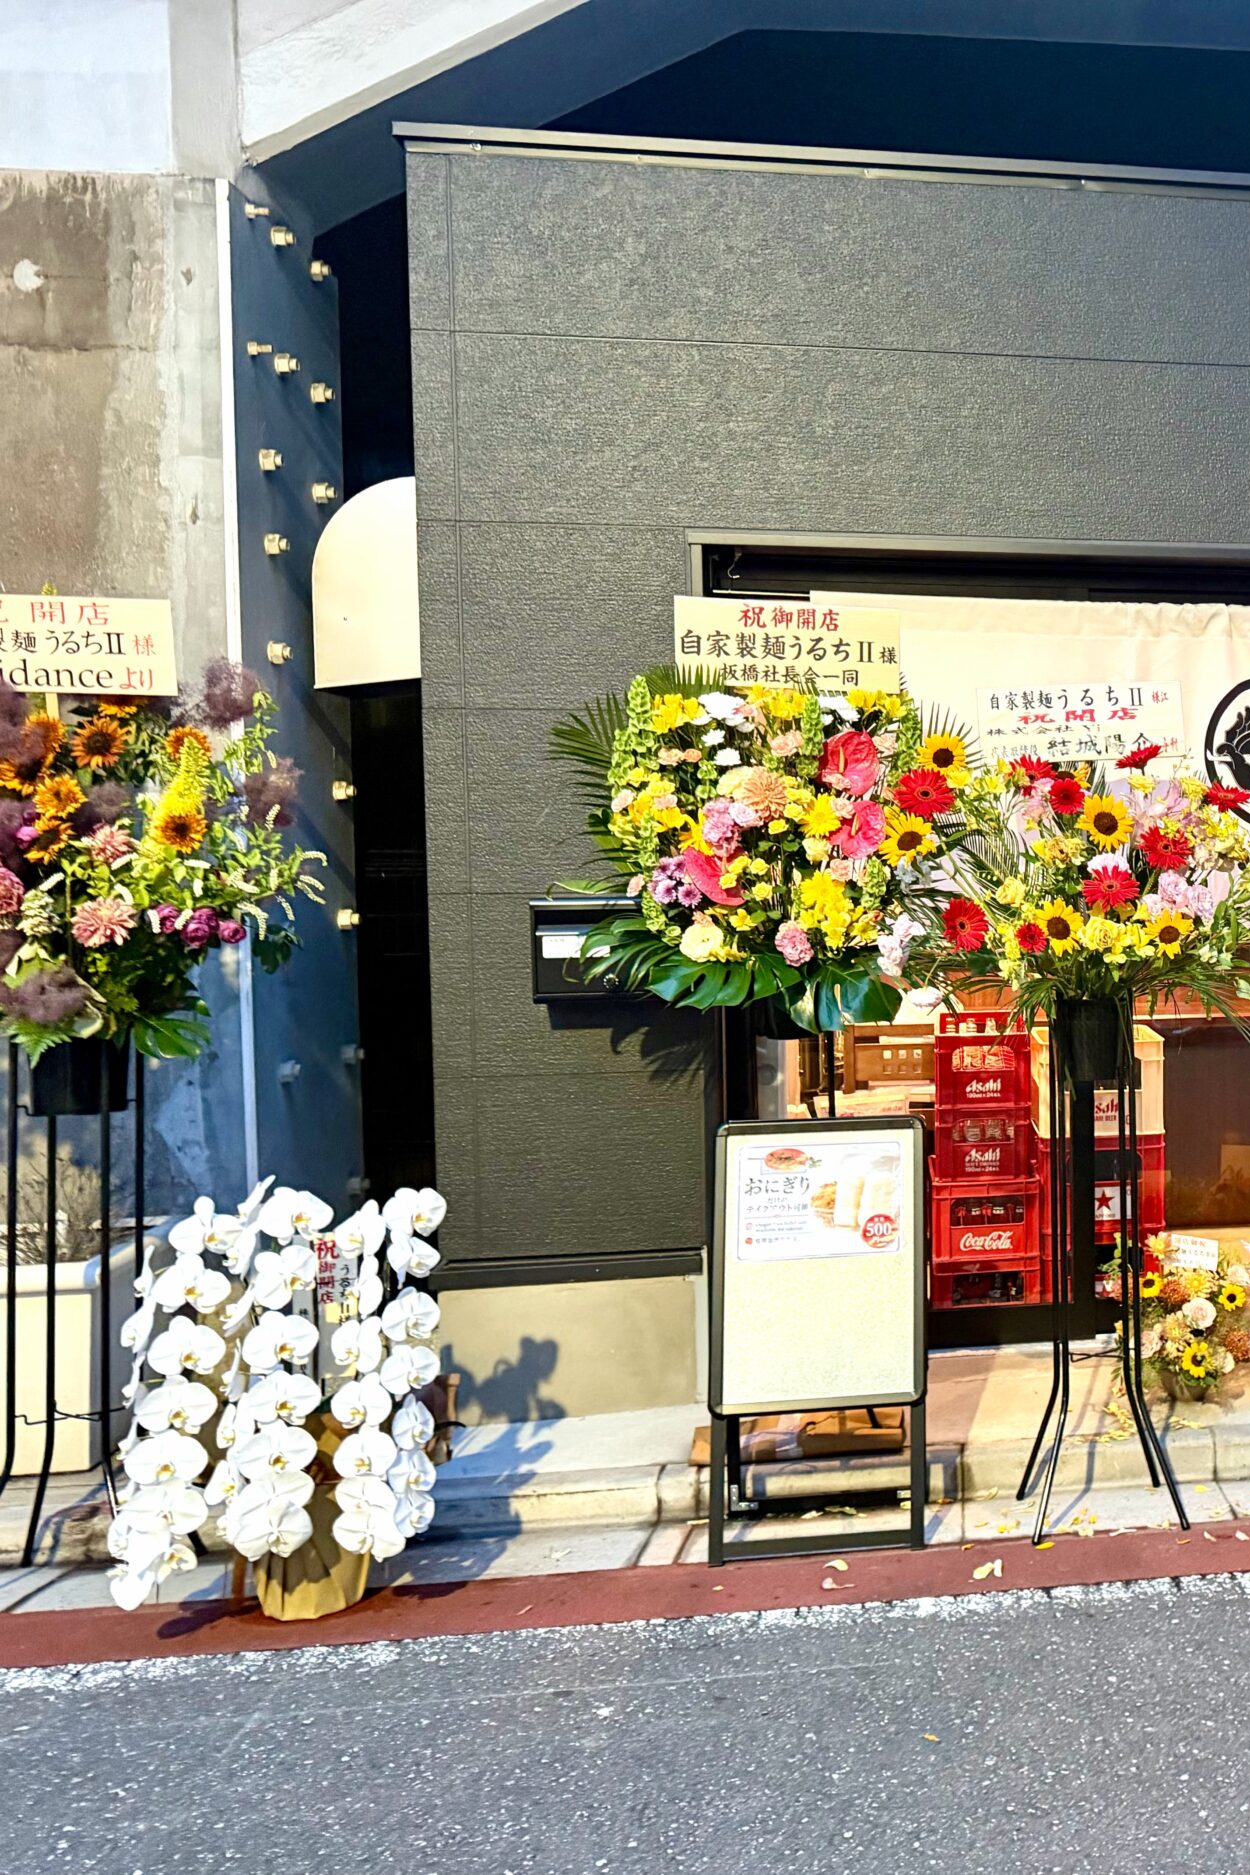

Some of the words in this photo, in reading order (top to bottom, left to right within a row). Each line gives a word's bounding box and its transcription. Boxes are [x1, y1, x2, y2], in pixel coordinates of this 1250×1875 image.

[738, 603, 840, 631] 祝御開店
[119, 667, 153, 690] より
[966, 1078, 1001, 1092] Asahi
[965, 1147, 1000, 1161] Asahi
[744, 1176, 810, 1196] おにぎり
[866, 1222, 891, 1237] 500
[960, 1231, 1013, 1251] Coca-Cola
